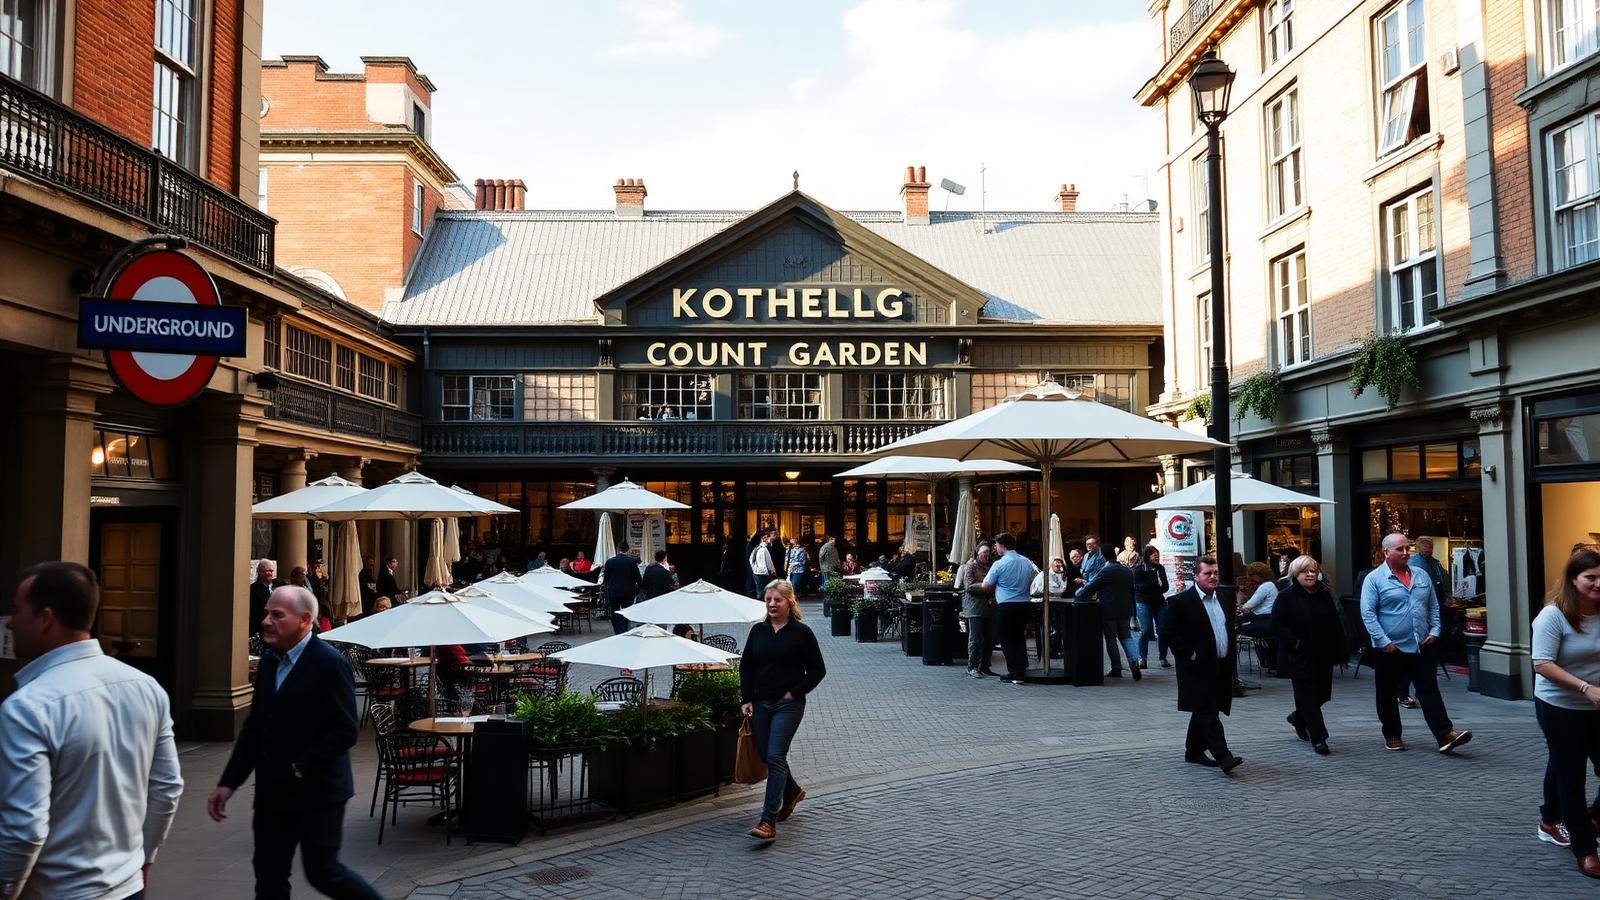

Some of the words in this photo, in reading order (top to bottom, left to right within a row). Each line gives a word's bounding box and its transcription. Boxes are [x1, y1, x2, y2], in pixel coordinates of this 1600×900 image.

[673, 288, 903, 318] KOTHELLG
[94, 314, 235, 339] UNDERGROUND
[646, 342, 767, 367] COUNT
[788, 342, 927, 367] GARDEN
